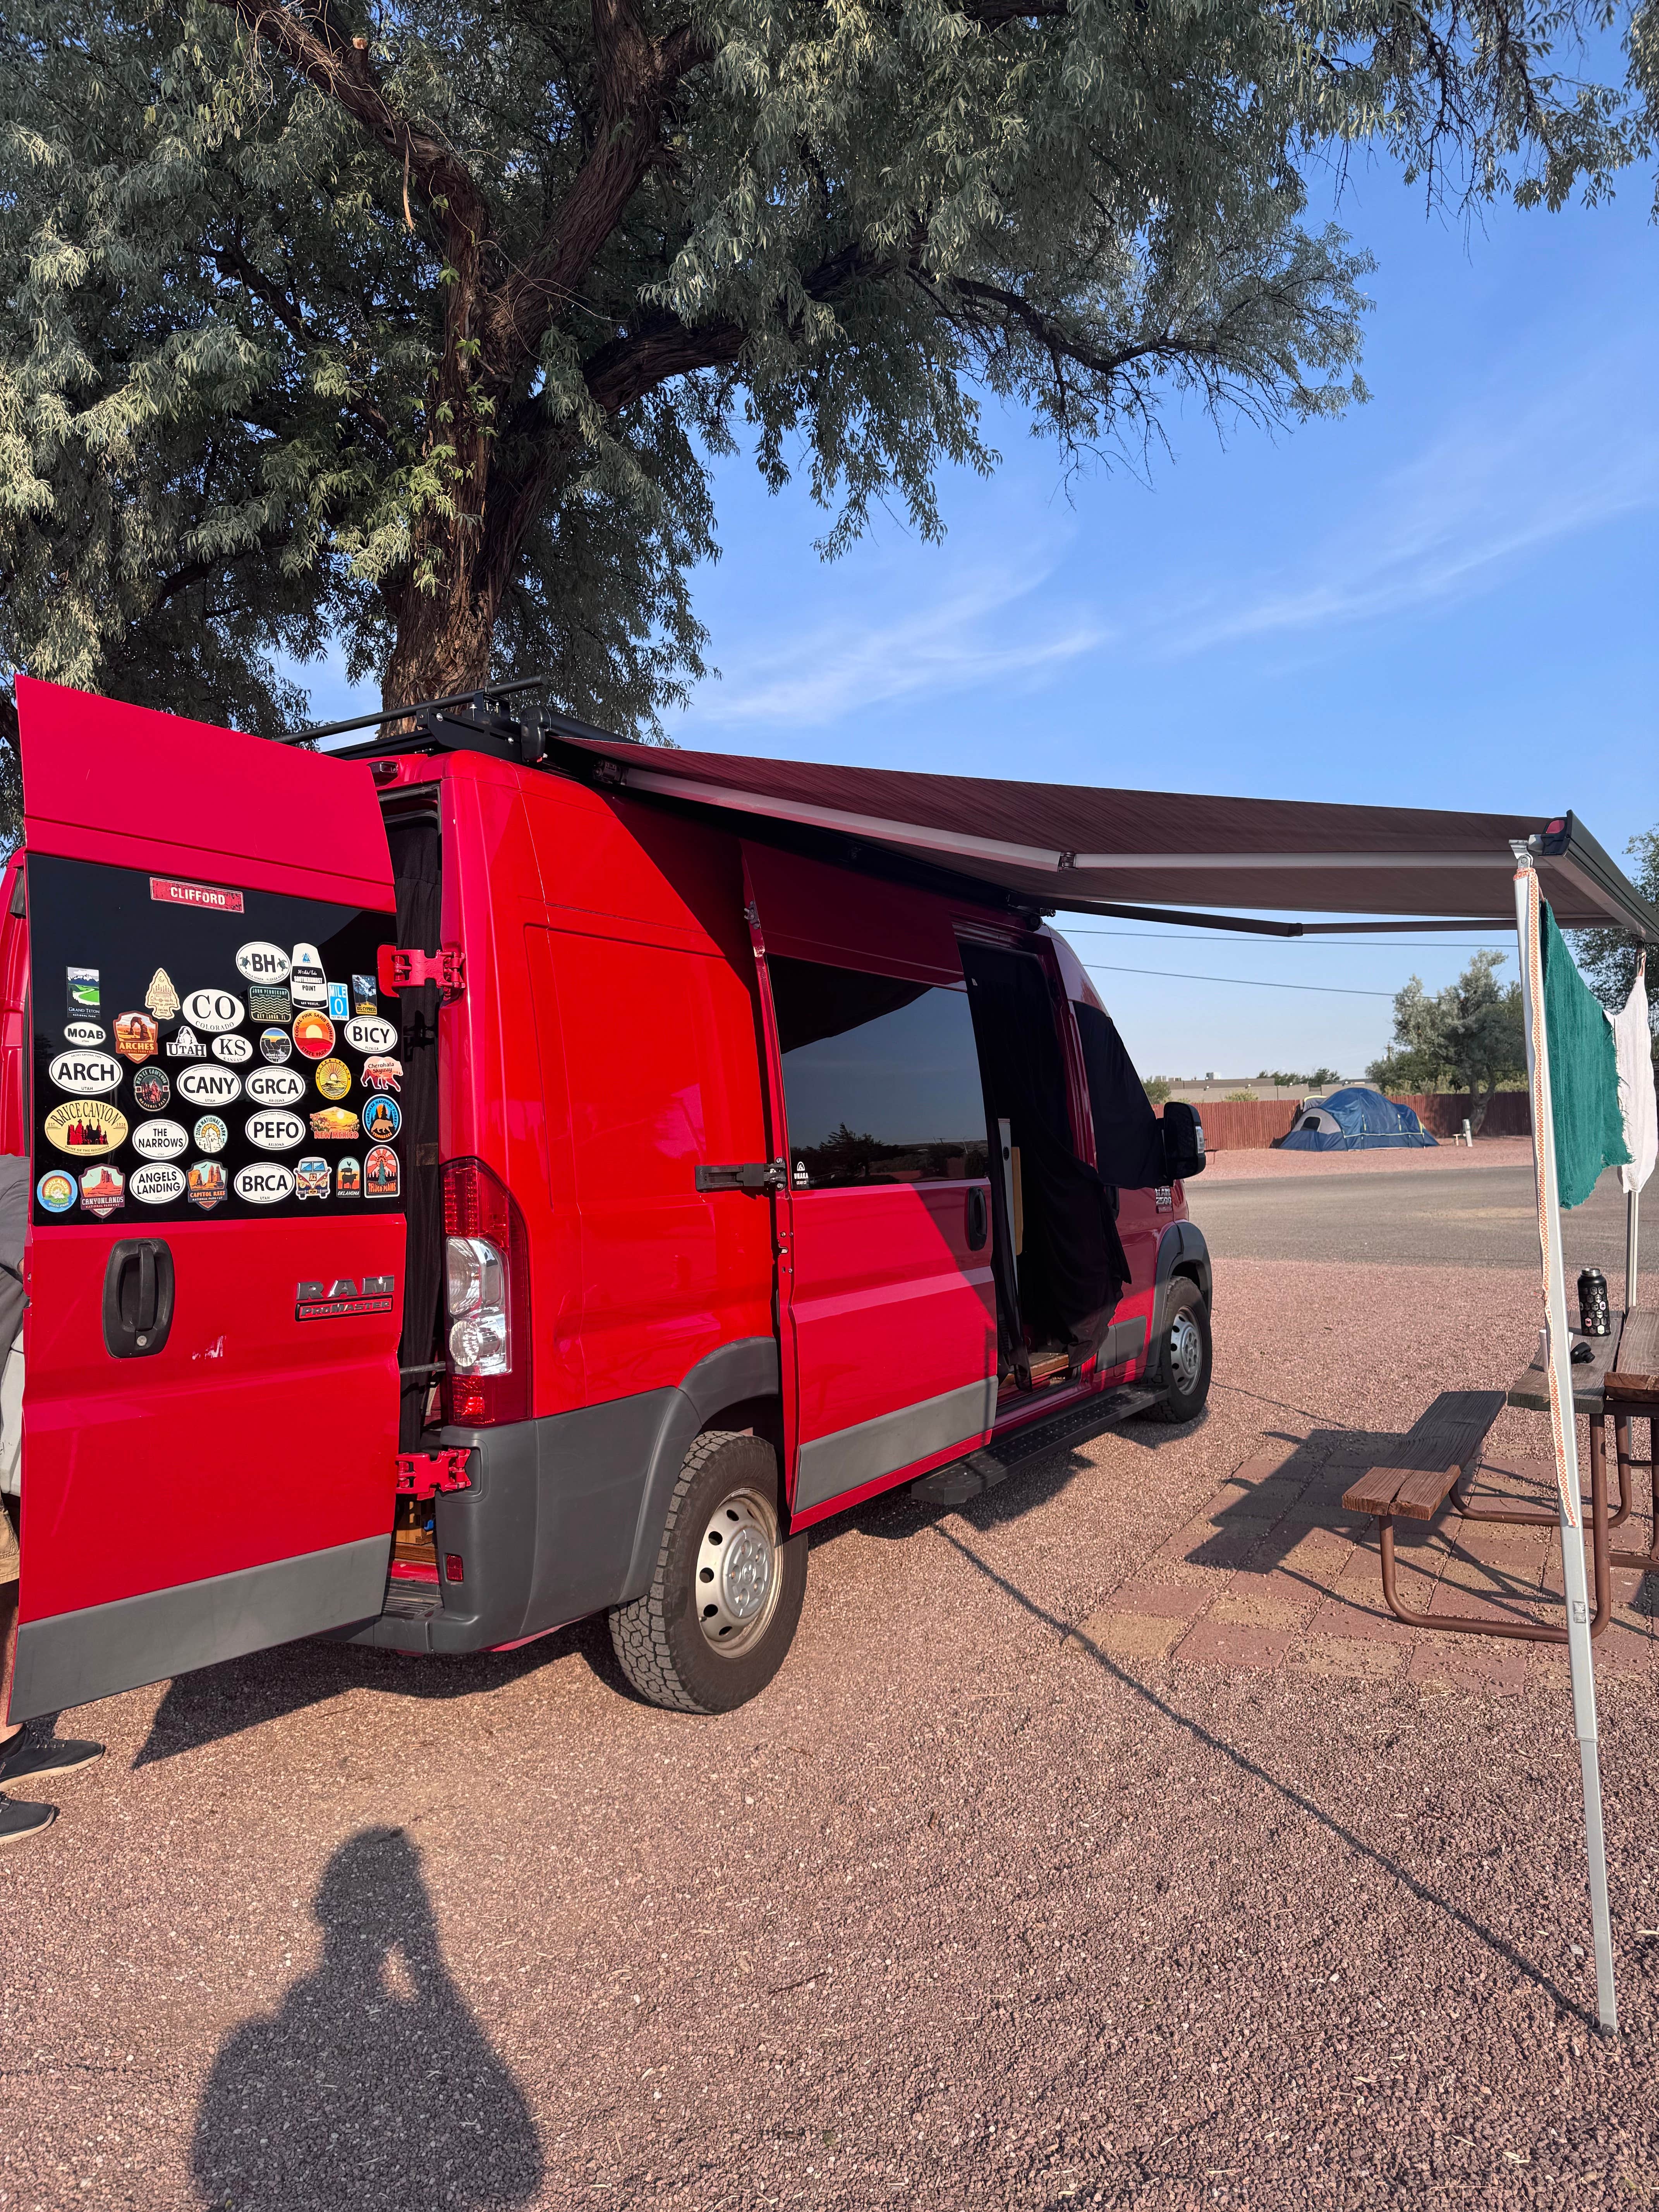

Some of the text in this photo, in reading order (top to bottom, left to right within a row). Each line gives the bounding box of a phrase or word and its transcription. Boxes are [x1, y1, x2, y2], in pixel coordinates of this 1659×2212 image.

[170, 887, 225, 905] CLIFFORD
[252, 953, 276, 972] BH
[330, 985, 346, 998] MILE
[192, 995, 235, 1020] CO
[335, 998, 343, 1014] 0
[314, 1013, 326, 1022] SAND
[196, 1021, 234, 1030] COLORADO
[68, 1028, 103, 1039] MOAB
[353, 1026, 390, 1043] BICY
[119, 1042, 154, 1050] ARCHES
[168, 1043, 205, 1056] UTAH
[219, 1038, 246, 1056] KS
[301, 1046, 314, 1056] STATE
[58, 1063, 114, 1081] ARCH
[184, 1076, 235, 1094] CANY
[252, 1079, 299, 1094] GRCA
[50, 1102, 122, 1127] BRYCE CANYON
[367, 1103, 375, 1125] CHEROKEE
[375, 1100, 392, 1108] NATIONAL
[200, 1117, 220, 1125] NATIONAL
[153, 1128, 167, 1137] THE
[254, 1122, 299, 1138] PEFO
[139, 1138, 183, 1148] NARROWS
[139, 1171, 177, 1183] ANGELS
[243, 1175, 288, 1192] BRCA
[137, 1182, 180, 1195] LANDING
[368, 1182, 396, 1192] TELLICO PLAINS
[82, 1197, 124, 1205] CANYONLANDS
[296, 1275, 394, 1300] RAM
[301, 1301, 389, 1316] PROMASTER
